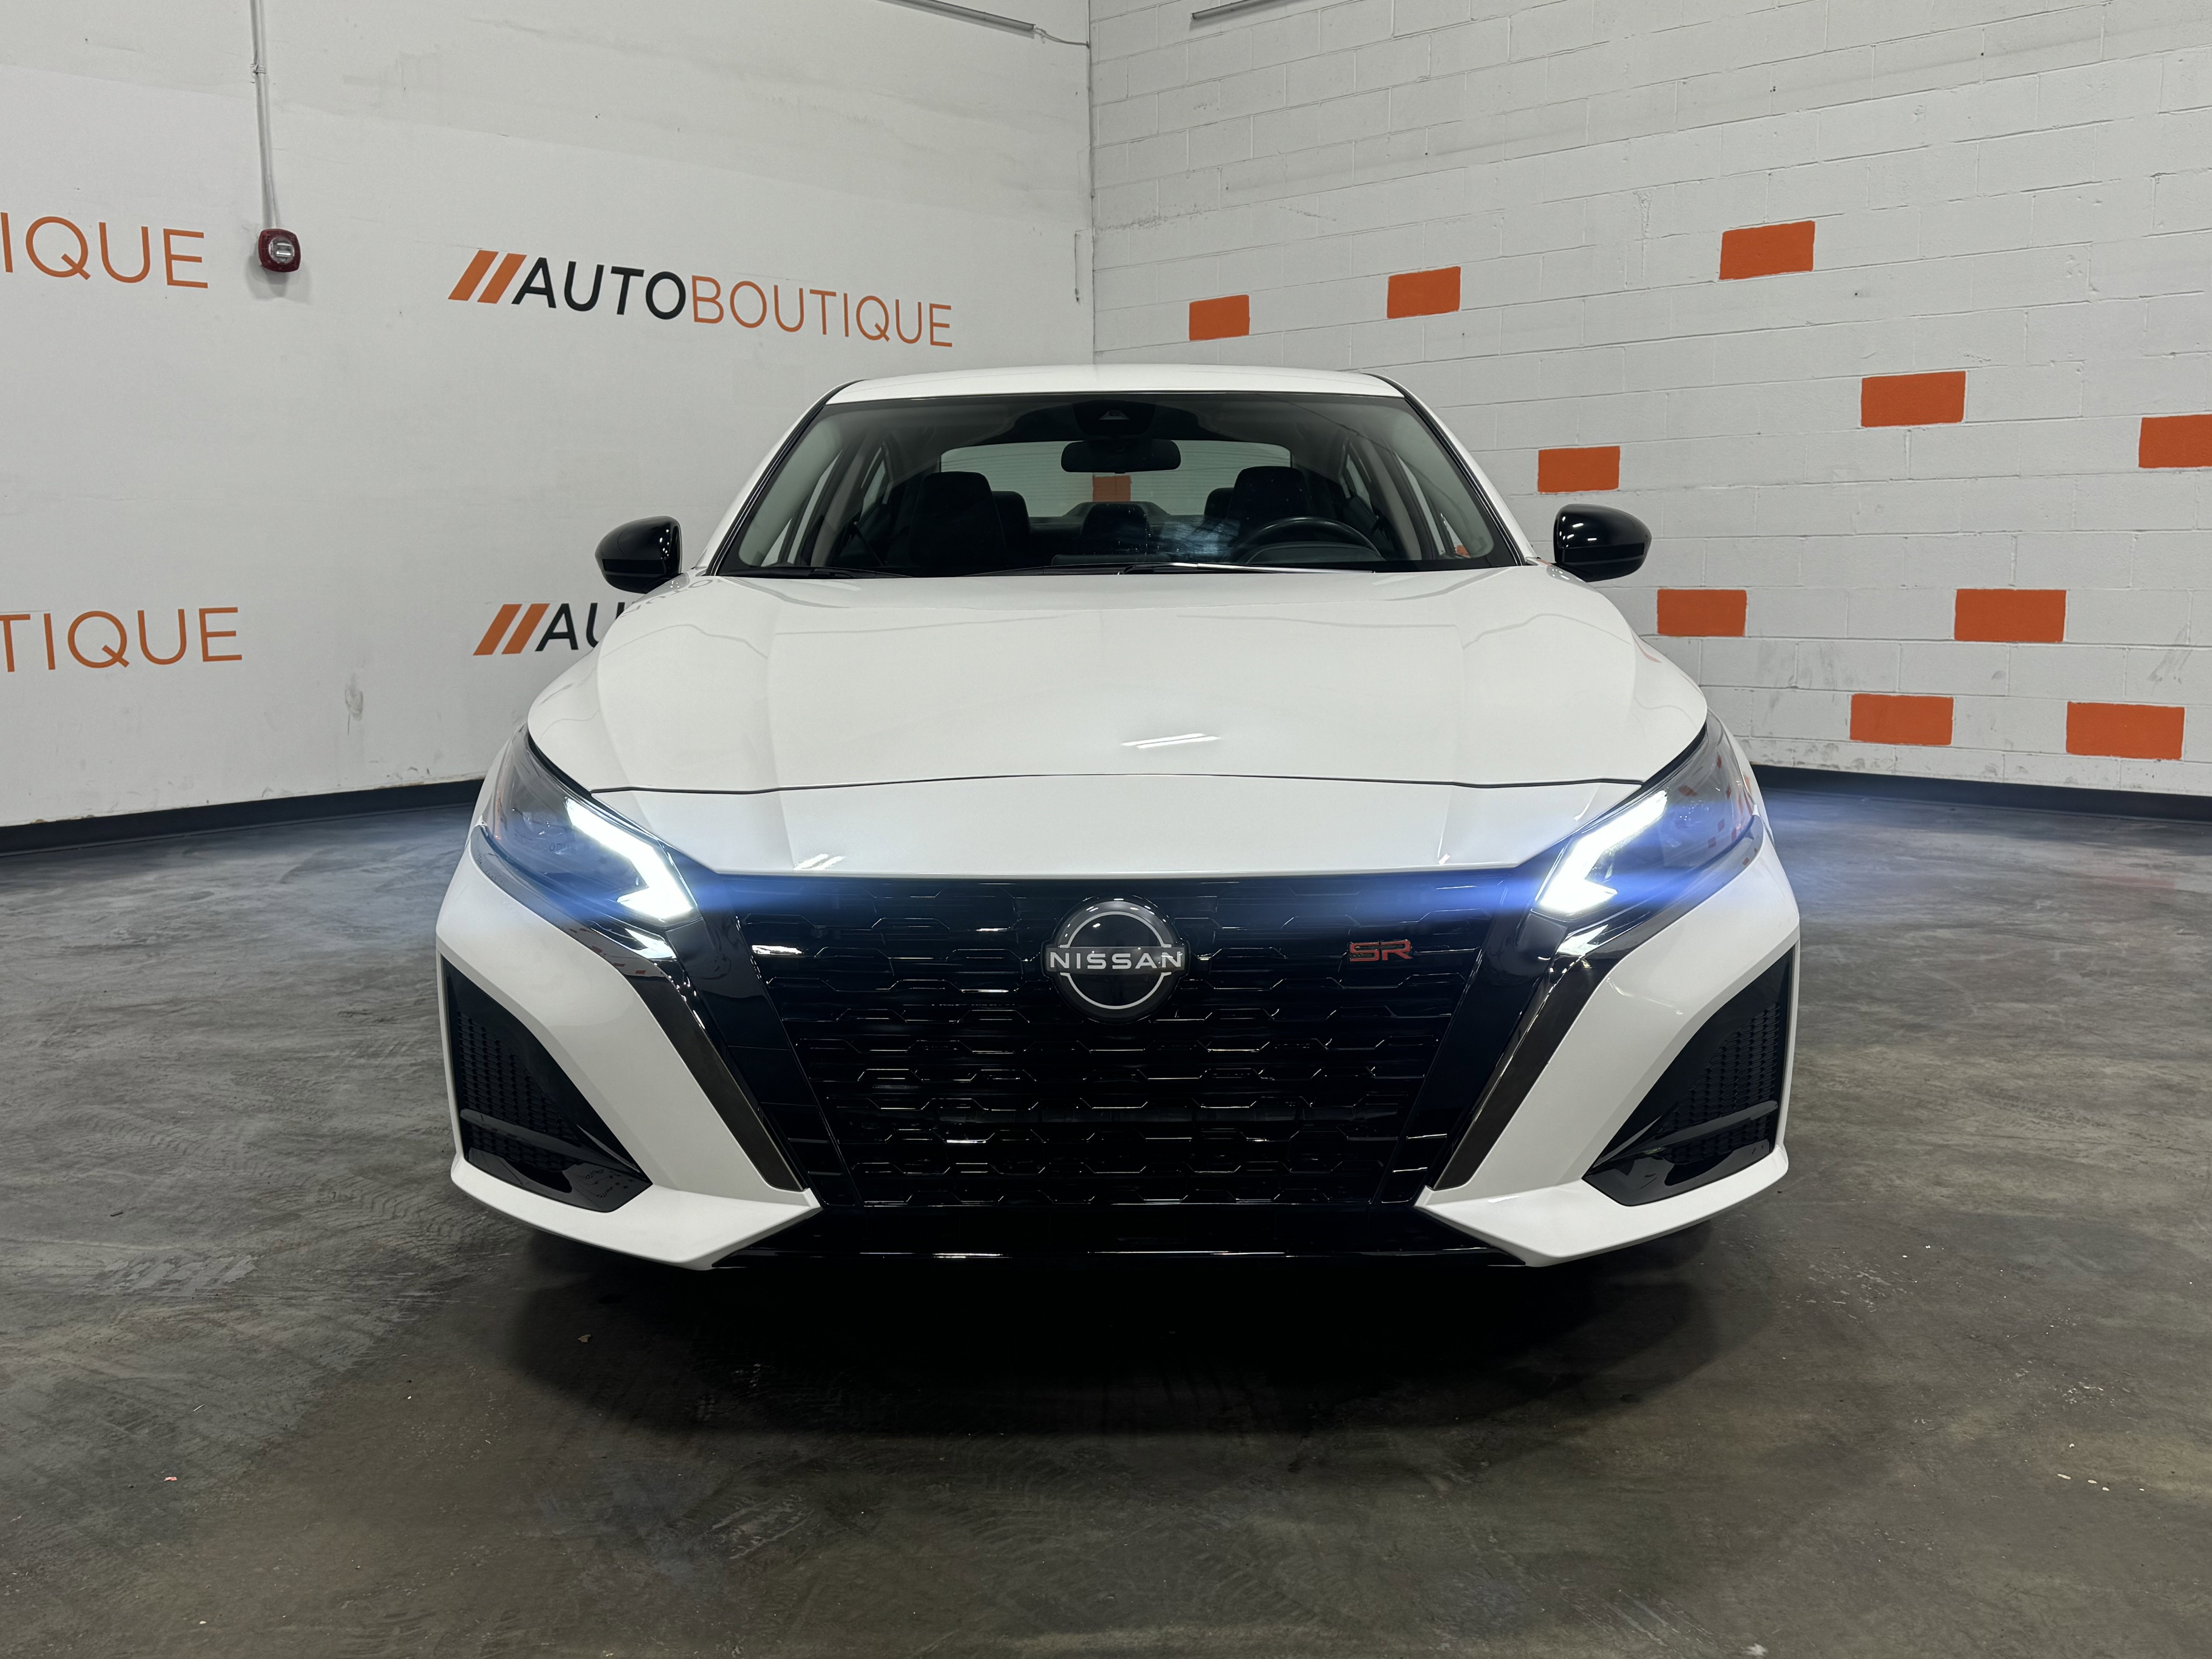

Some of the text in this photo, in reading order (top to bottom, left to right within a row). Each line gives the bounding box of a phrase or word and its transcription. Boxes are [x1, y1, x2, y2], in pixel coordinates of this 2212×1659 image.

[0, 212, 208, 289] IQUE
[511, 257, 953, 348] AUTOBOUTIQUE
[0, 607, 242, 673] TIQUE
[1050, 951, 1183, 970] NISSAN
[1350, 939, 1412, 962] SR
